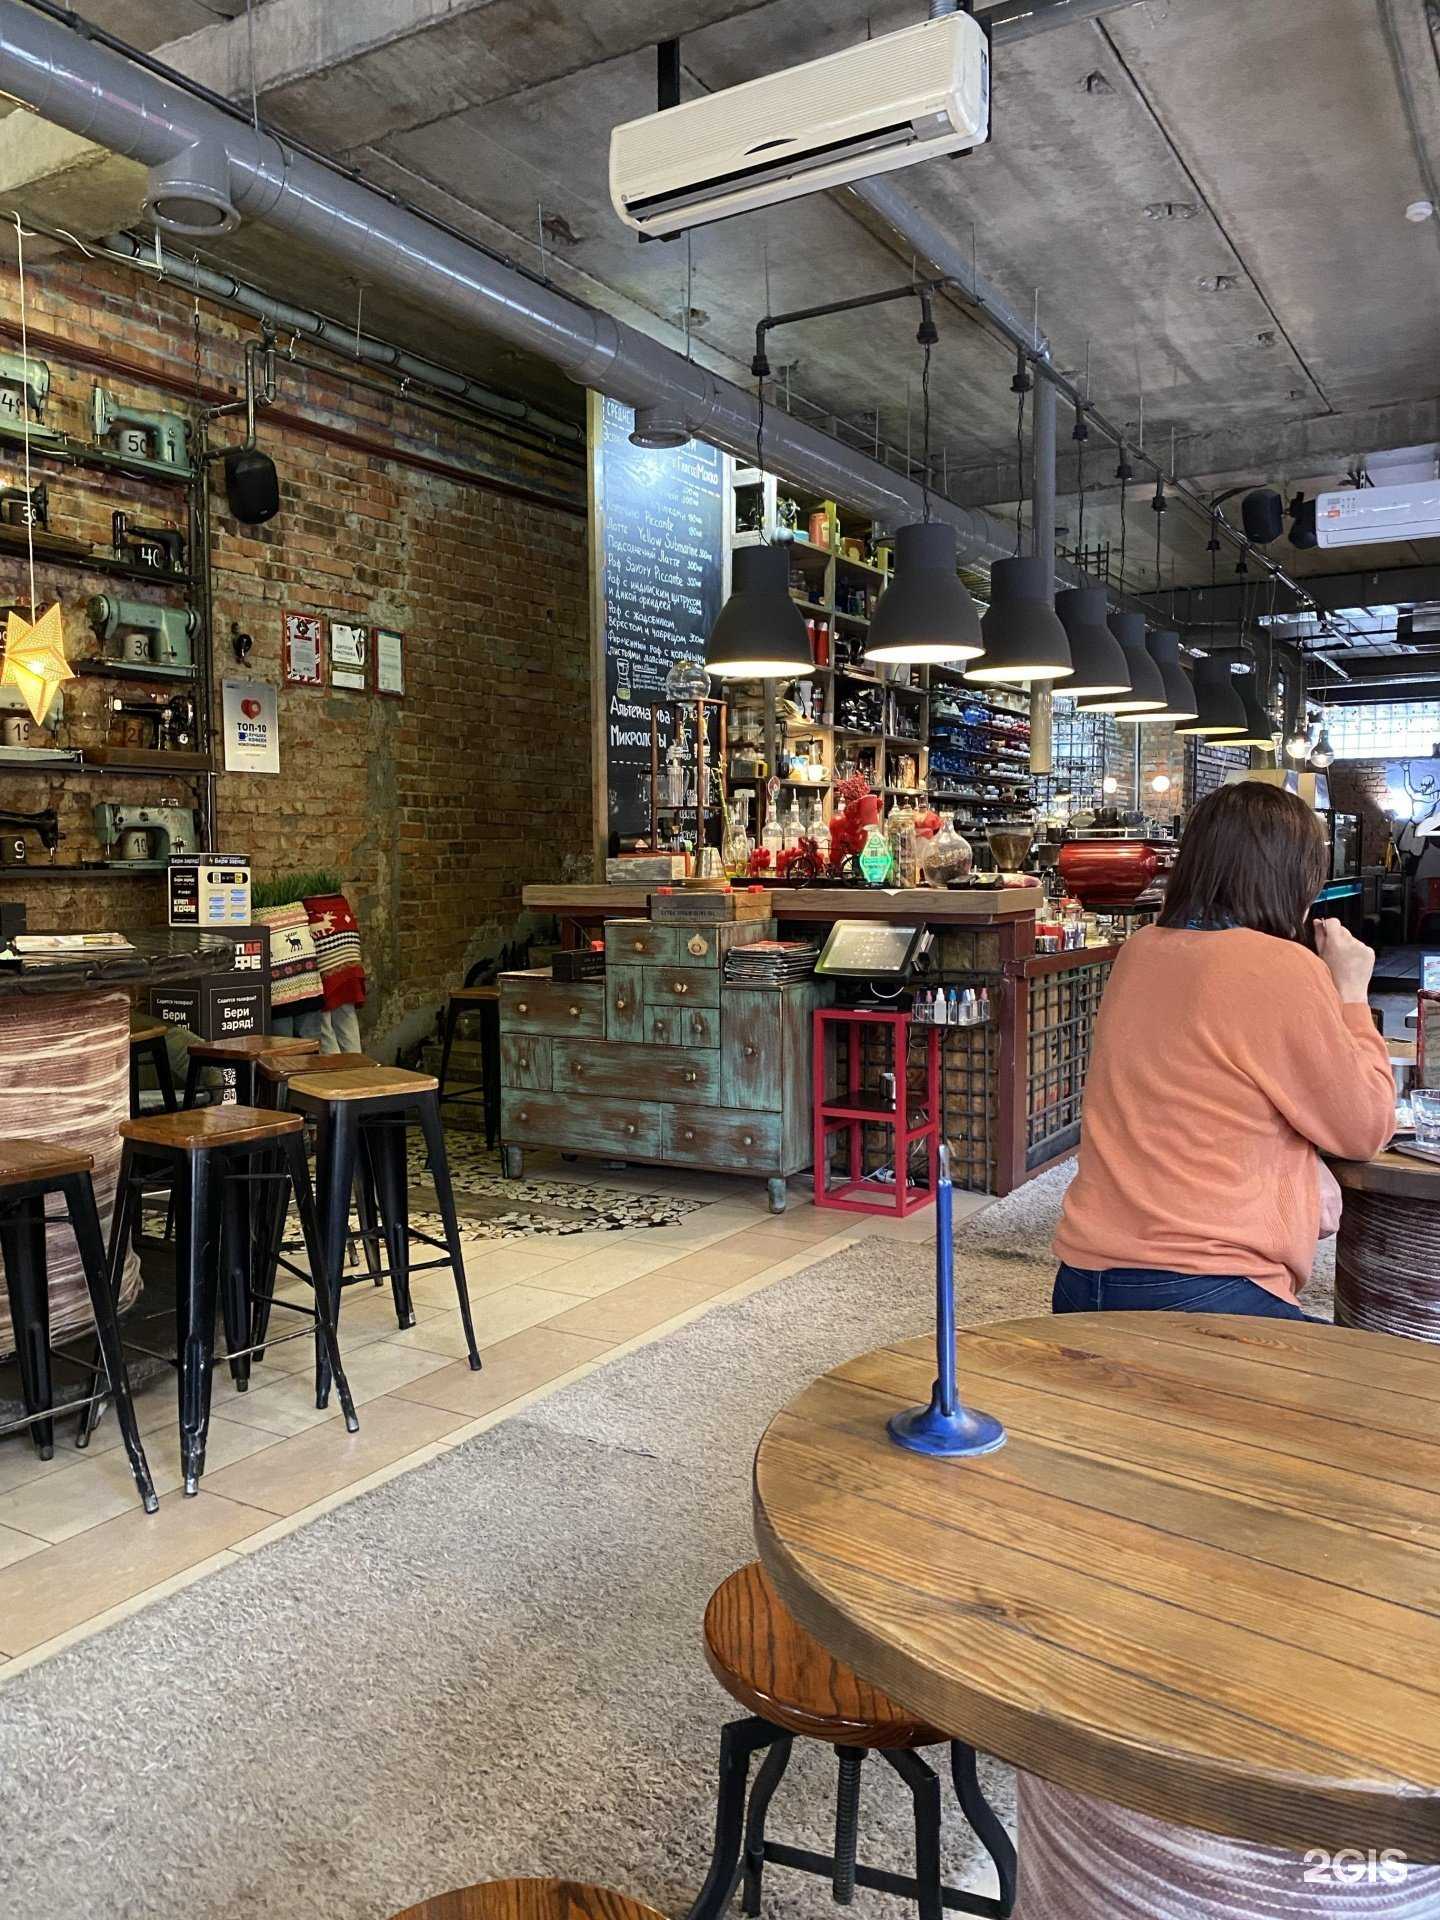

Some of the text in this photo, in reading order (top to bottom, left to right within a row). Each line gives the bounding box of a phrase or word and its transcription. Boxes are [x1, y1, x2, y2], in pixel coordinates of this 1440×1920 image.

[637, 526, 662, 548] Yellow
[664, 533, 698, 557] Submarine
[658, 550, 681, 567] Латте
[625, 557, 652, 577] Savory
[654, 565, 684, 586] Piccante
[615, 589, 637, 602] дикой
[651, 628, 687, 646] чабрецом
[13, 722, 30, 741] 19
[237, 722, 267, 733] ТОП-10
[610, 724, 667, 748] Микролоы
[162, 1009, 186, 1021] Бери
[224, 1007, 250, 1019] Бери
[221, 1017, 254, 1031] заряд!
